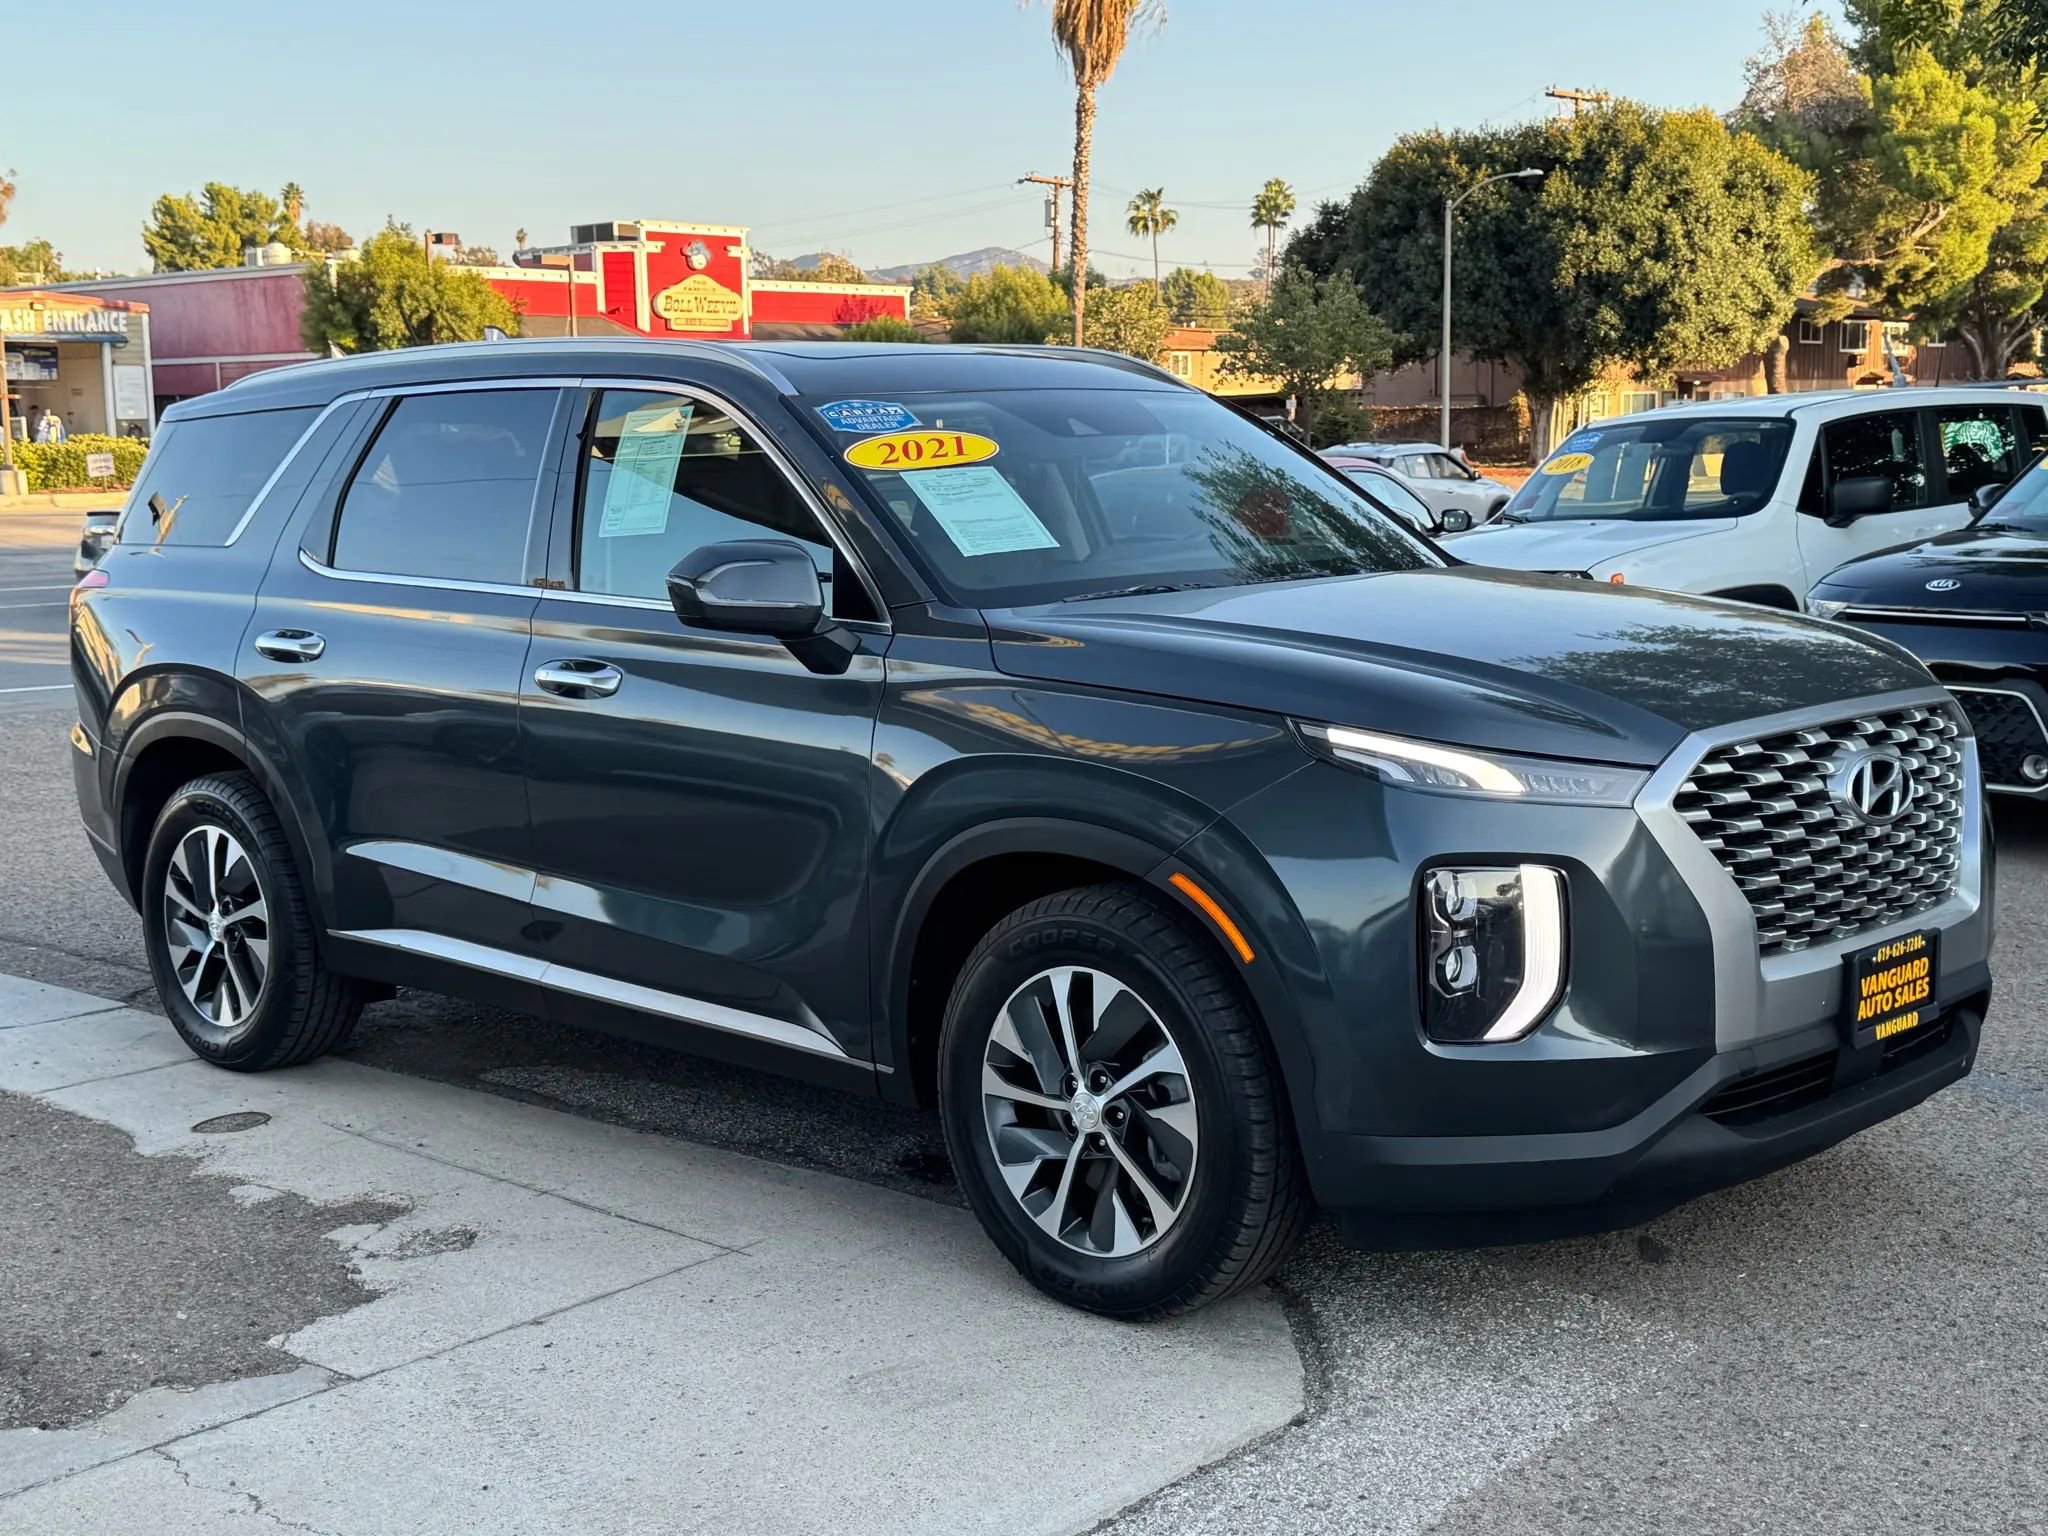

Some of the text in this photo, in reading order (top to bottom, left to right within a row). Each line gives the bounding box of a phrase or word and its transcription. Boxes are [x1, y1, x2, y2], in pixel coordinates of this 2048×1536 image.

[43, 310, 128, 333] ENTRANCE
[827, 407, 905, 418] CARFAX
[840, 414, 905, 426] ADVANTAGE
[856, 421, 900, 431] DEALER
[877, 435, 969, 466] 2021
[1930, 579, 1953, 588] KIA
[1008, 928, 1117, 957] COOPER
[1861, 956, 1930, 998] VANGUARD
[1857, 976, 1930, 1022] AUTO SALES
[1875, 1010, 1919, 1041] VANGUARD
